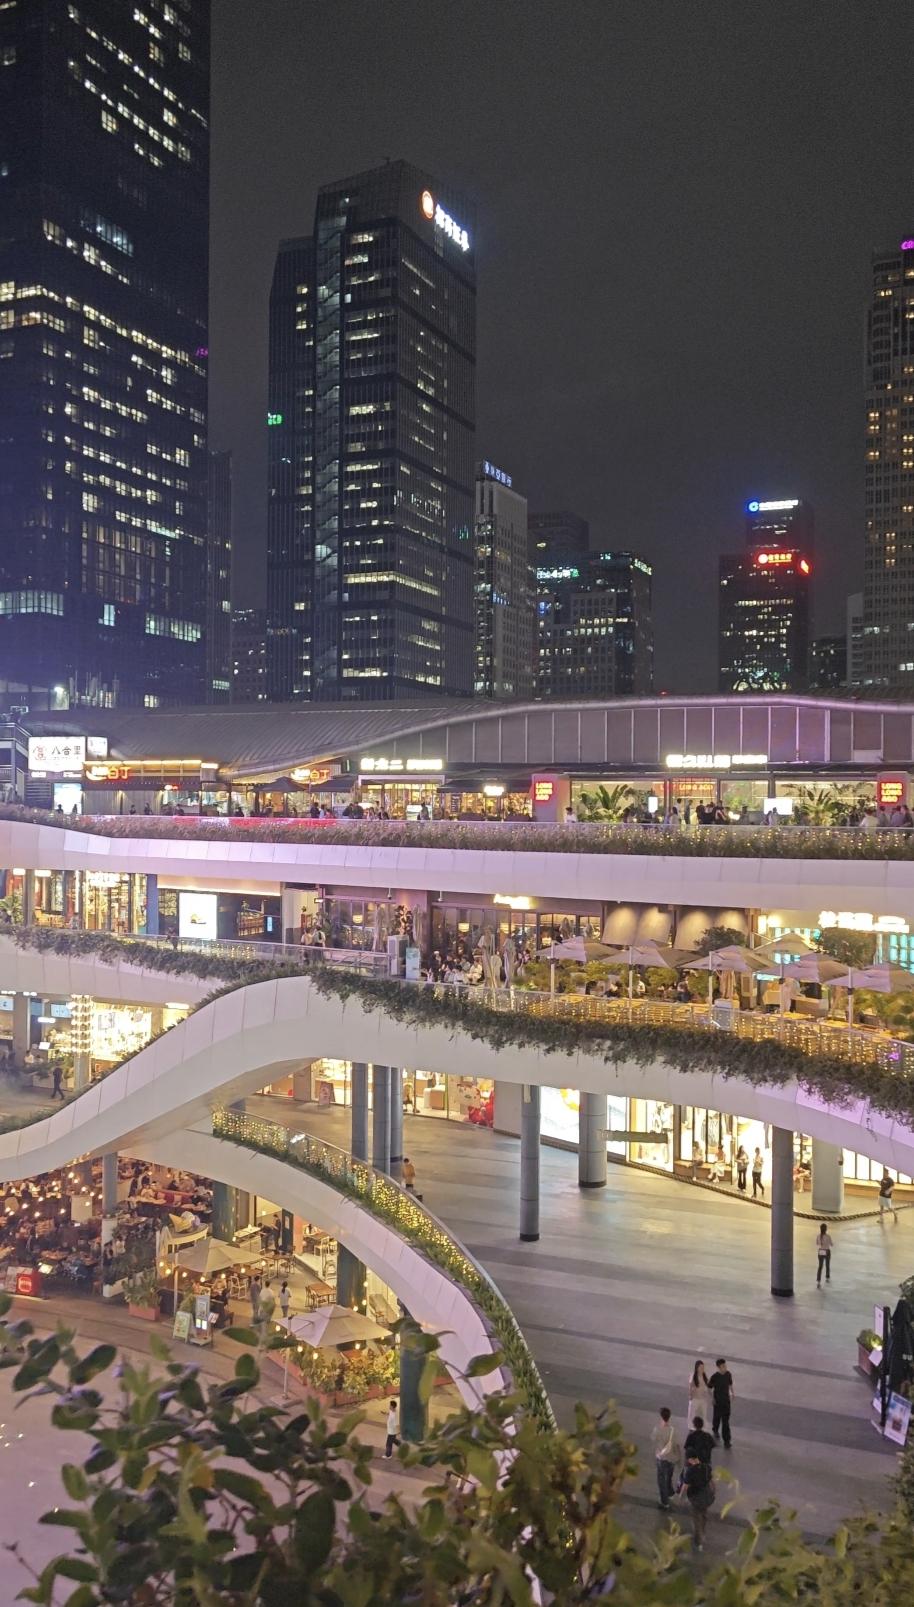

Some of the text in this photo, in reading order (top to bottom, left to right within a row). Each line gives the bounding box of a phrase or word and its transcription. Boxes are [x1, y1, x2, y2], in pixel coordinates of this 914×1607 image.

[51, 745, 81, 756] 八合里
[881, 782, 903, 790] LONG
